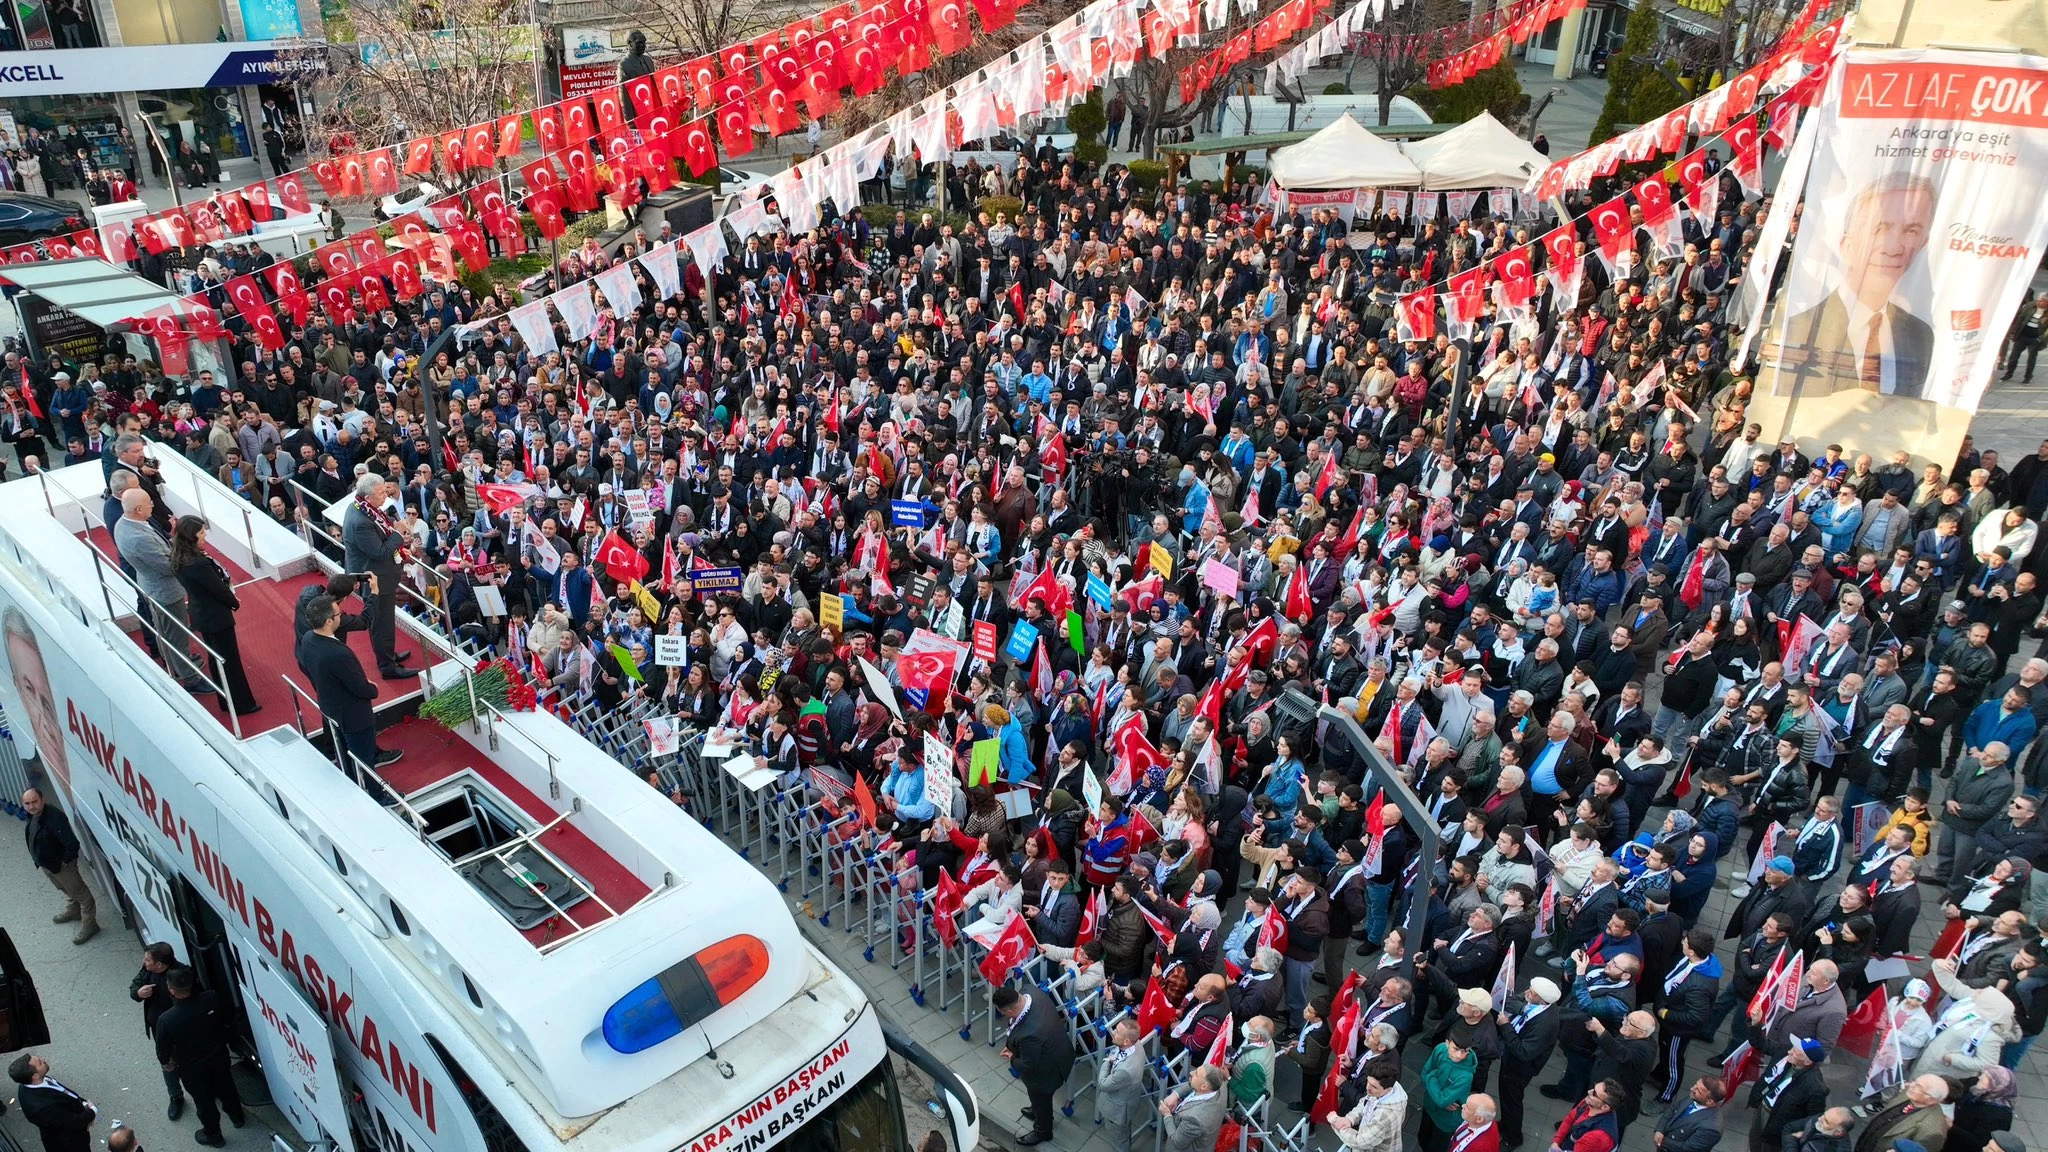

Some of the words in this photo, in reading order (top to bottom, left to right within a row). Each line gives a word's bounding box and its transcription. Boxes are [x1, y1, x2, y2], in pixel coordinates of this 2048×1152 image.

[242, 61, 272, 74] AYIK
[1852, 72, 1898, 108] AZ
[1903, 72, 1966, 111] LAF,
[1970, 75, 2044, 117] ÇOK
[1890, 125, 1974, 145] Ankara'ya
[1978, 132, 2011, 149] eşit
[1874, 143, 1928, 159] hizmet
[1931, 145, 2017, 167] görevimiz
[1948, 222, 2013, 244] Mansur
[1948, 238, 2030, 260] BAŞKAN
[1953, 330, 1979, 341] CHP
[697, 578, 736, 587] YIKILMAZ
[67, 696, 250, 929] ANKARA'NIN
[253, 896, 437, 1135] BAŞKANI
[773, 1039, 851, 1106] BAŞKANI
[767, 1071, 846, 1138] BAŞKANI
